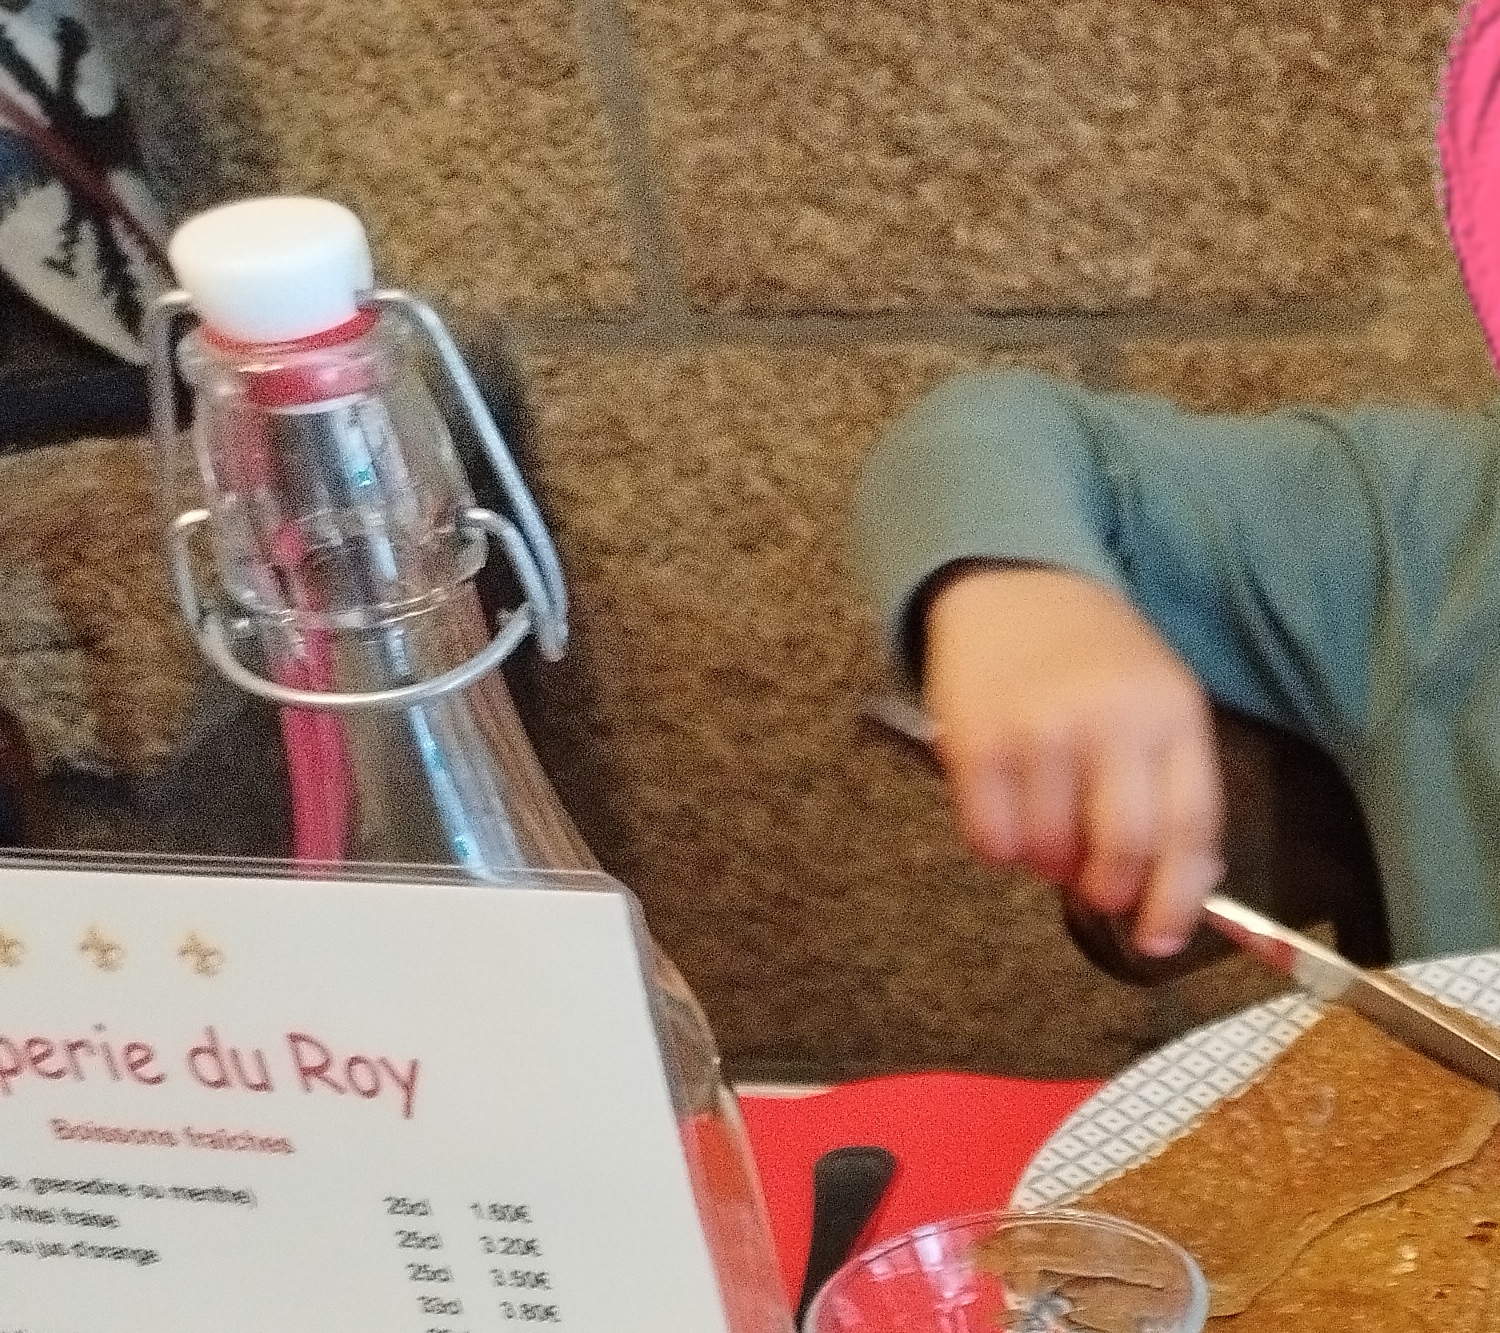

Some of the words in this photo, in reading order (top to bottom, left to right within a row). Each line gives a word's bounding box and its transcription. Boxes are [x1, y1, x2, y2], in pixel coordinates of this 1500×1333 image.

[186, 1025, 274, 1093] du
[286, 1031, 420, 1120] Roy
[50, 1117, 178, 1147] Boissons
